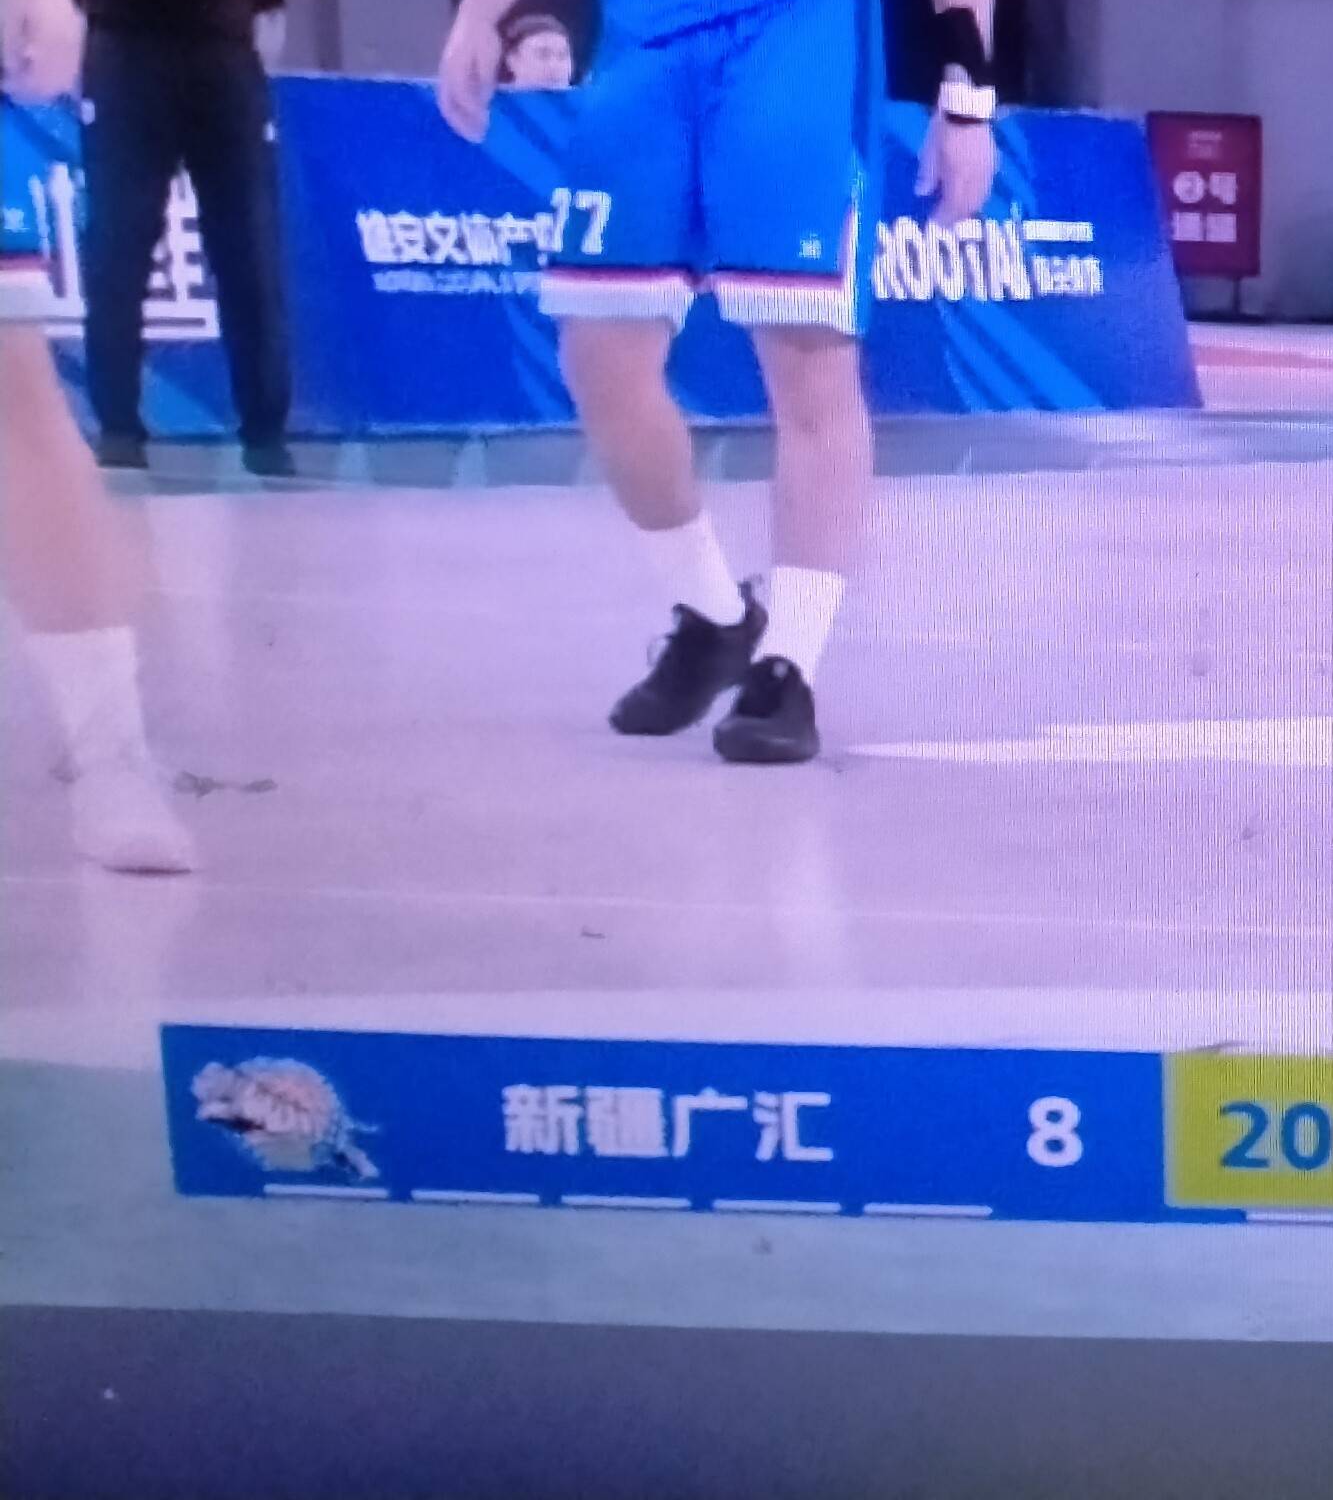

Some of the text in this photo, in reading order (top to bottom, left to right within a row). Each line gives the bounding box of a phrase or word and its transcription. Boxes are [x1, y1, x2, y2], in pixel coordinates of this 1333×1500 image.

[502, 1082, 1084, 1169] 新疆广汇 8
